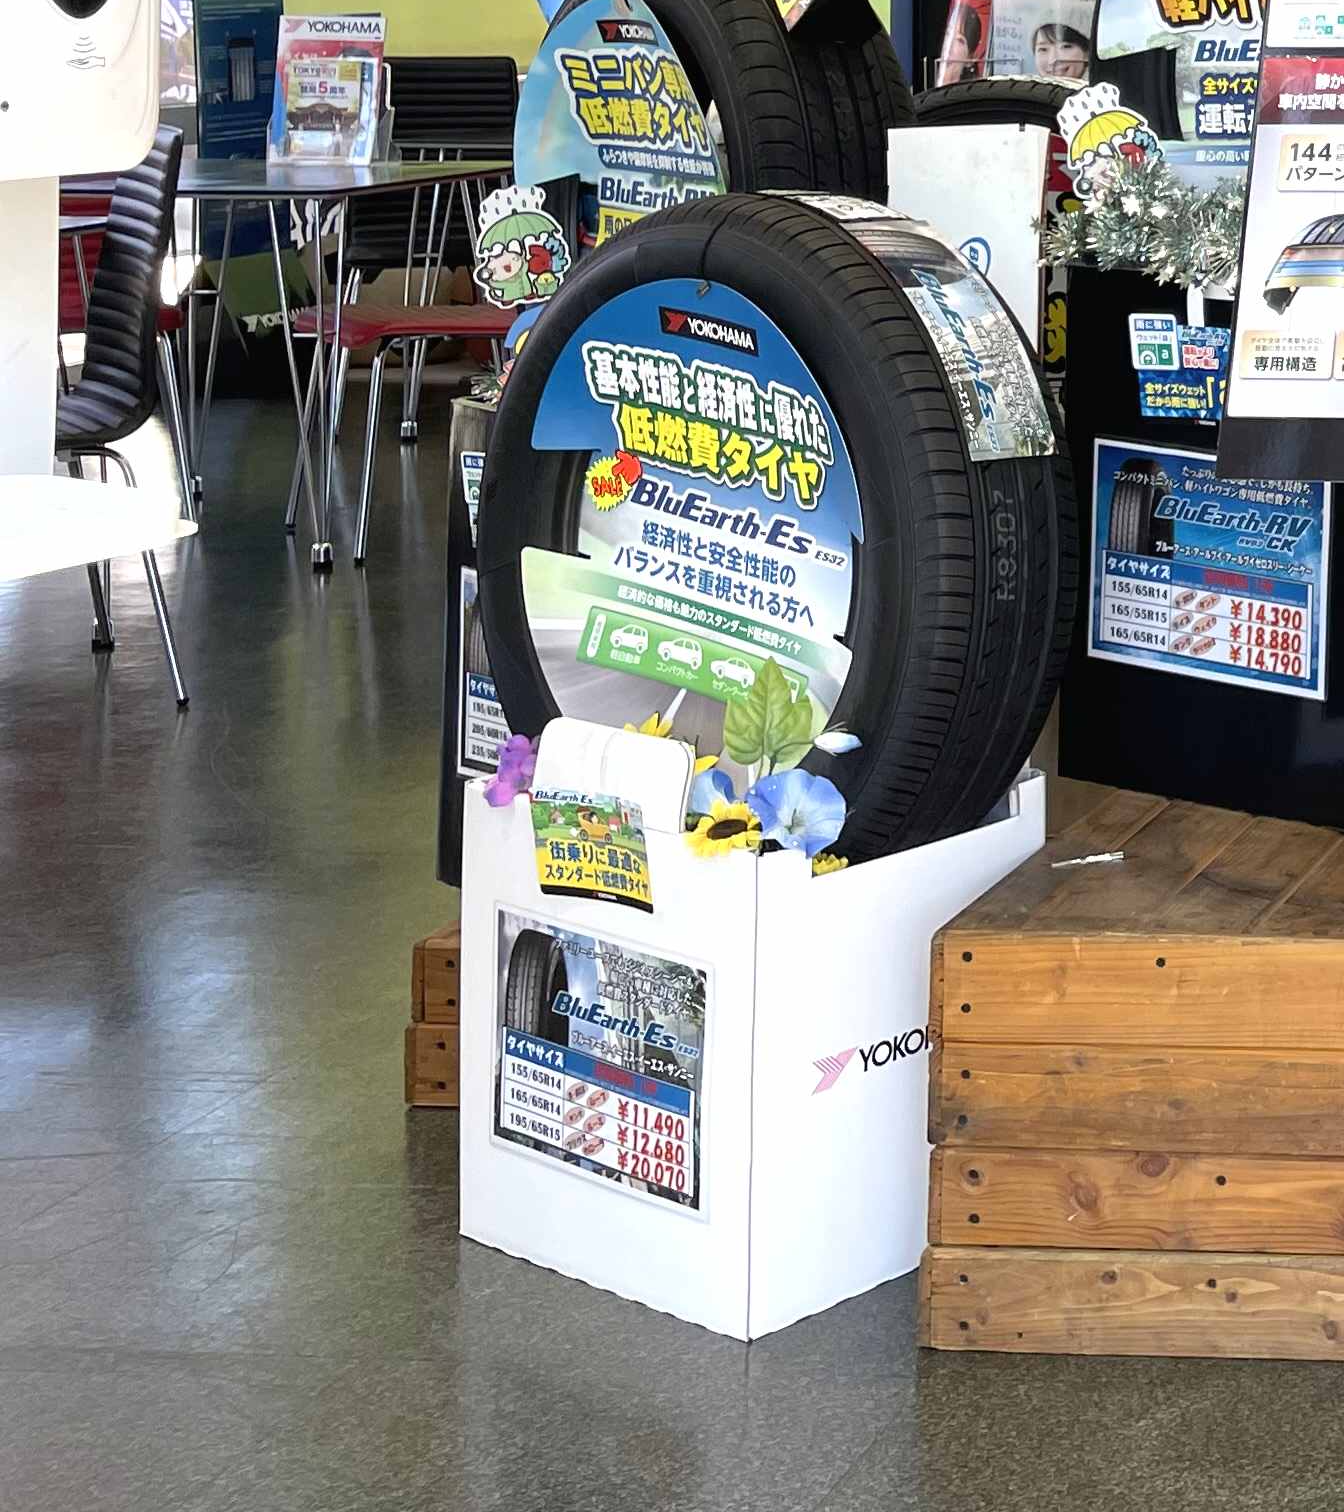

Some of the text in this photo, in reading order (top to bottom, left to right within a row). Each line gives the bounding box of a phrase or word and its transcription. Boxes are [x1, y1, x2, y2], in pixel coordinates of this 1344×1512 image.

[306, 18, 382, 34] YOKOHAMA
[1289, 142, 1333, 163] 144
[687, 316, 755, 351] YOKOHAMA
[1253, 356, 1318, 374] 専用構造
[589, 347, 829, 457] 基本性能と経済性に優れた
[619, 403, 820, 500] 低燃費タイヤ
[591, 475, 624, 498] SALE
[630, 478, 813, 555] BluEarth-Es
[1155, 495, 1312, 539] BluEarth-RV
[641, 519, 797, 588] 経済性と安全性能の
[1265, 536, 1297, 556] CK
[1106, 555, 1171, 581] タイヤサイズ
[613, 545, 815, 628] バランスを重視される方へ
[1111, 579, 1169, 601] 155/65R14
[1111, 602, 1168, 625] 165/55R15
[1109, 625, 1167, 648] 165/65R14
[534, 789, 579, 804] BluEarth
[547, 839, 644, 875] 街乗りに最適な
[551, 990, 677, 1051] BluEarth-Es
[506, 1034, 565, 1069] タイヤサイズ
[509, 1062, 562, 1091] 155/65R14
[509, 1087, 561, 1117] 165/65R14
[508, 1111, 561, 1142] 195/65R15
